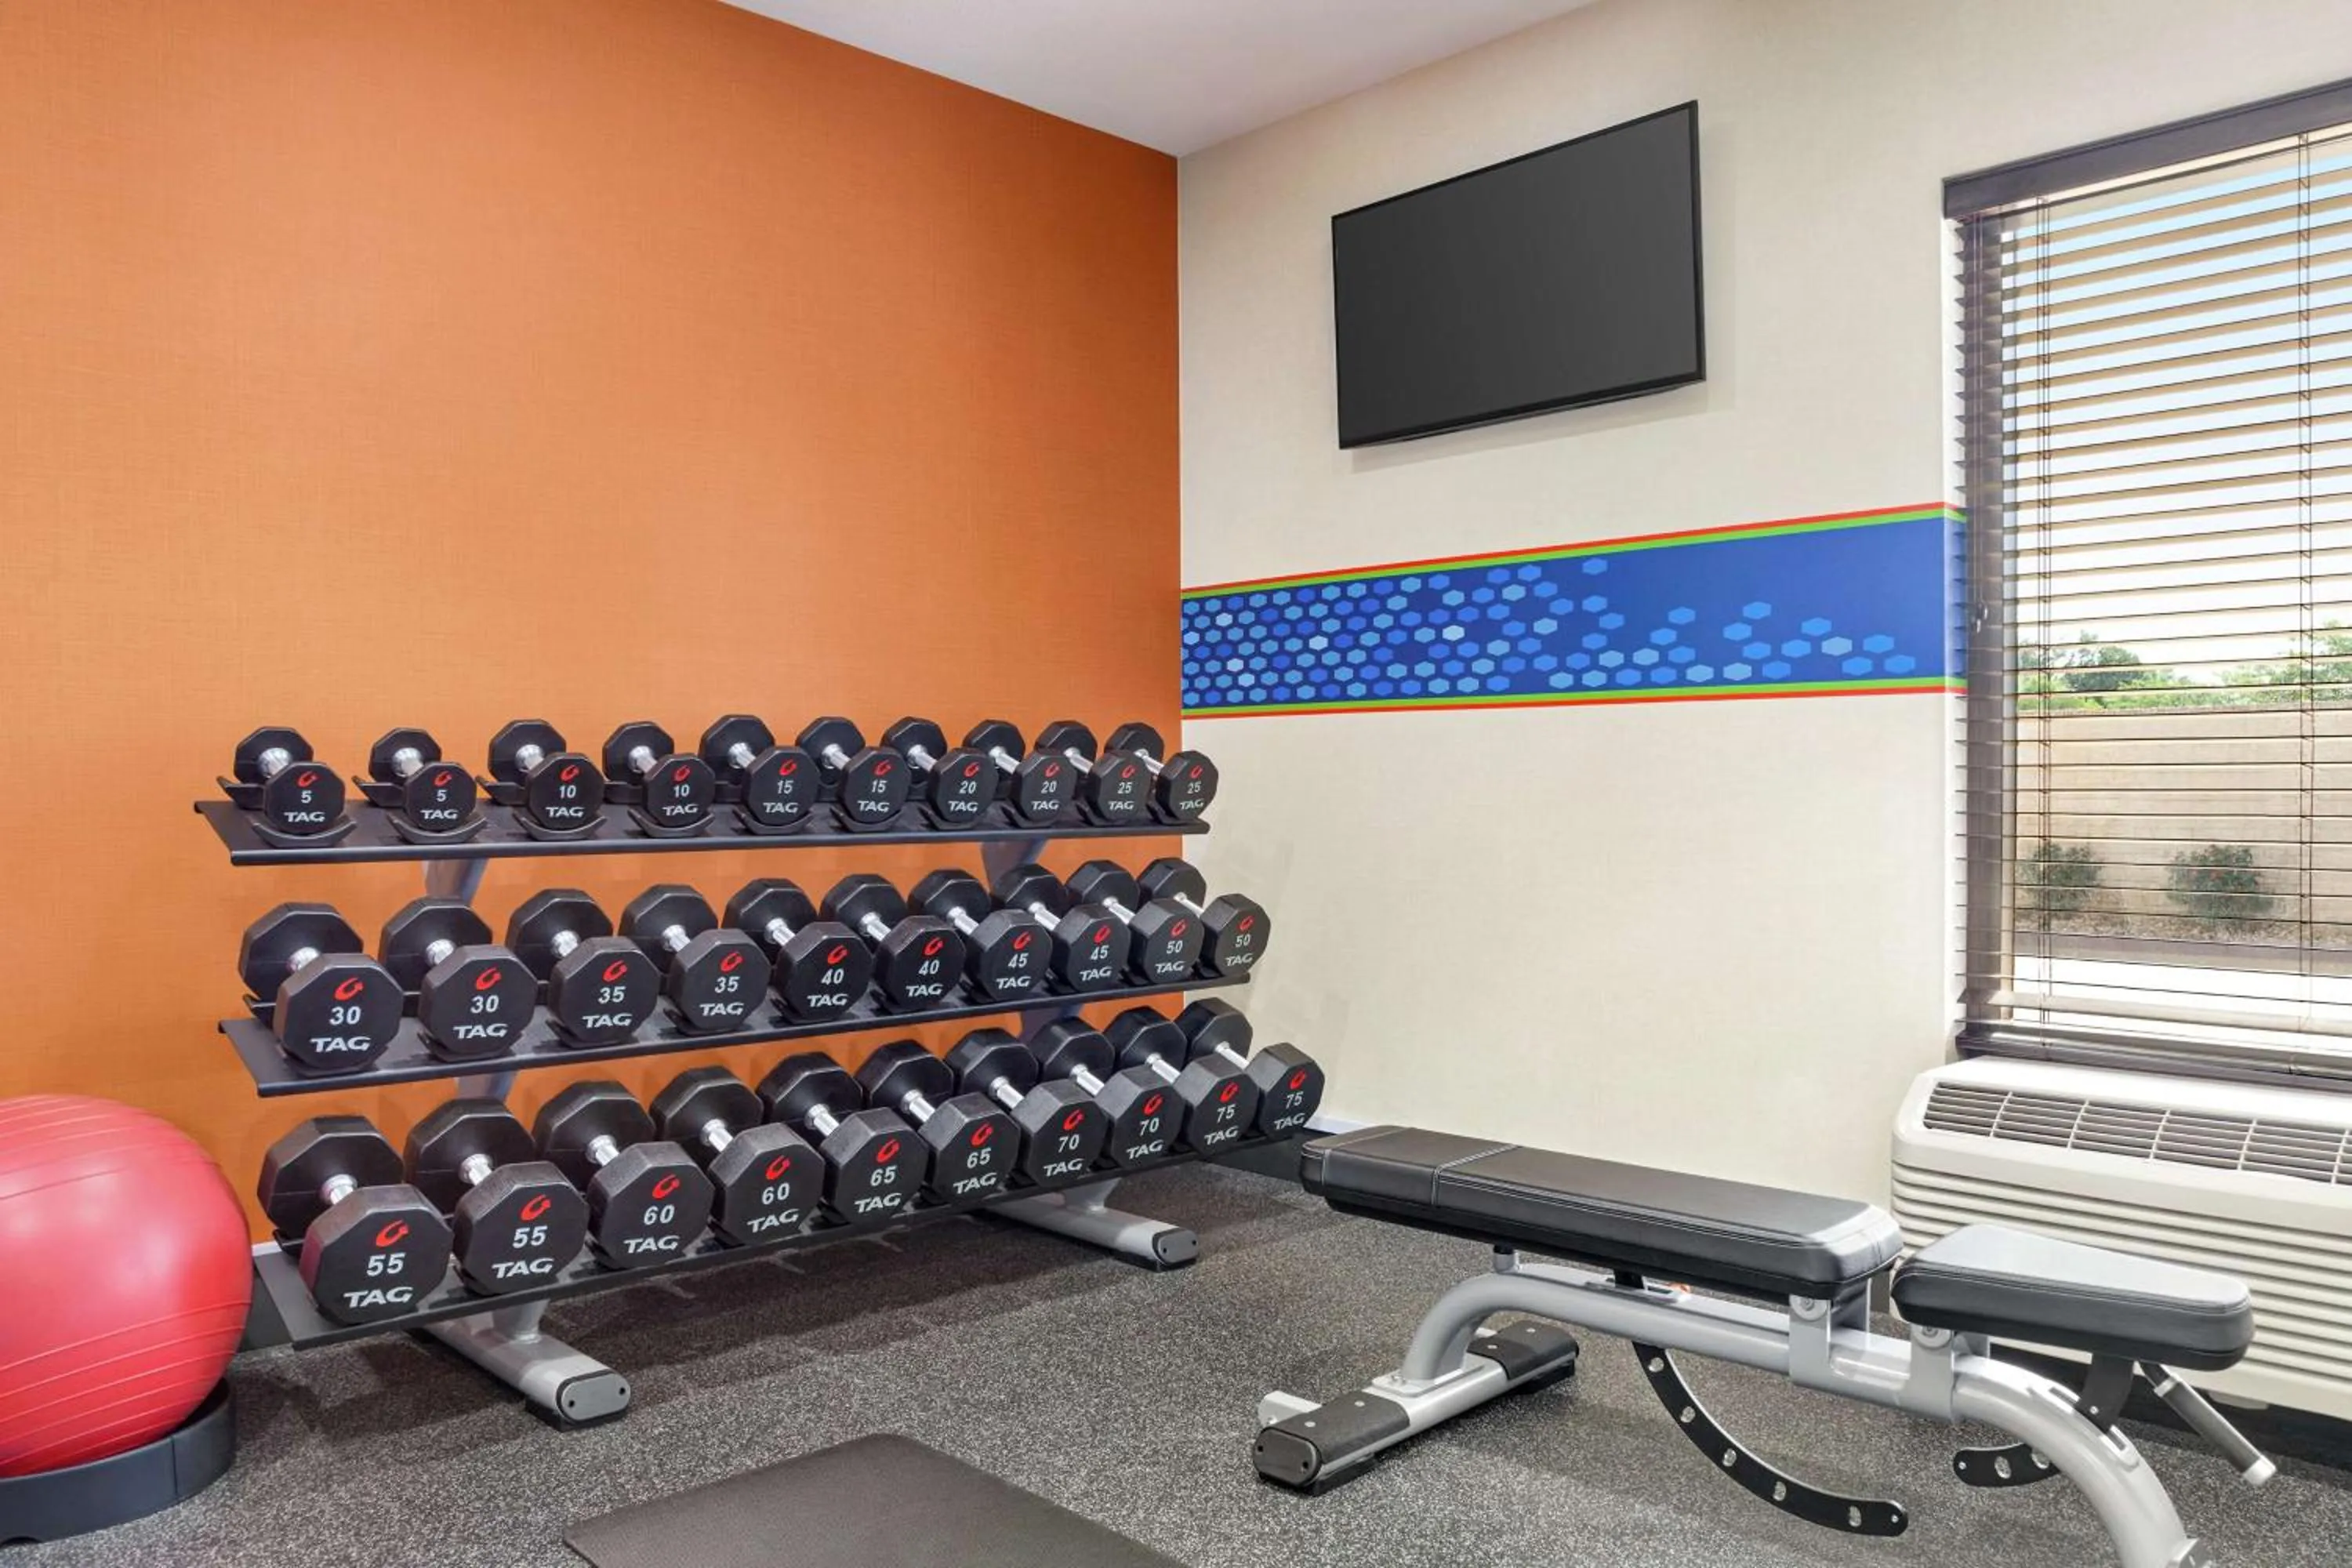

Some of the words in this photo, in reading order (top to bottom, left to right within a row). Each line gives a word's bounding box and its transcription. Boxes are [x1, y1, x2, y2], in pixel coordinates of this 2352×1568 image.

[560, 784, 576, 799] 10
[673, 784, 690, 798] 10
[777, 779, 794, 794] 15
[871, 779, 887, 793] 15
[959, 780, 977, 794] 20
[1040, 780, 1058, 794] 20
[1116, 781, 1133, 794] 25
[1187, 780, 1202, 794] 25
[300, 789, 312, 804] 5
[436, 789, 447, 802] 5
[545, 806, 584, 818] TAG
[662, 804, 698, 816] TAG
[763, 802, 798, 813] TAG
[857, 800, 890, 813] TAG
[948, 800, 978, 812] TAG
[1031, 800, 1059, 811] TAG
[1108, 800, 1134, 811] TAG
[1178, 798, 1204, 811] TAG
[284, 811, 325, 822] TAG
[420, 808, 458, 820] TAG
[1166, 939, 1183, 954] 50
[1235, 933, 1251, 948] 50
[1007, 953, 1029, 968] 45
[1090, 945, 1109, 960] 45
[1225, 953, 1253, 967] TAG
[918, 959, 940, 976] 40
[1080, 966, 1112, 982] TAG
[1155, 960, 1185, 974] TAG
[714, 975, 740, 993] 35
[821, 968, 844, 985] 40
[996, 975, 1031, 989] TAG
[597, 985, 626, 1004] 35
[906, 983, 943, 998] TAG
[470, 994, 499, 1014] 30
[807, 993, 848, 1007] TAG
[328, 1005, 361, 1026] 30
[699, 1001, 744, 1017] TAG
[582, 1012, 633, 1029] TAG
[452, 1022, 507, 1040] TAG
[310, 1036, 371, 1053] TAG
[1286, 1091, 1304, 1109] 75
[1217, 1103, 1236, 1123] 75
[1274, 1112, 1305, 1130] TAG
[1140, 1117, 1160, 1136] 70
[1058, 1134, 1080, 1152] 70
[1204, 1126, 1238, 1145] TAG
[1126, 1139, 1163, 1160] TAG
[967, 1147, 992, 1169] 65
[1044, 1158, 1083, 1177] TAG
[869, 1165, 897, 1187] 65
[953, 1172, 997, 1194] TAG
[761, 1182, 790, 1205] 60
[854, 1192, 902, 1214] TAG
[643, 1203, 675, 1225] 60
[746, 1208, 798, 1233] TAG
[512, 1225, 548, 1249] 55
[623, 1235, 680, 1254] TAG
[366, 1252, 406, 1277] 55
[492, 1257, 554, 1279] TAG
[343, 1286, 413, 1308] TAG
